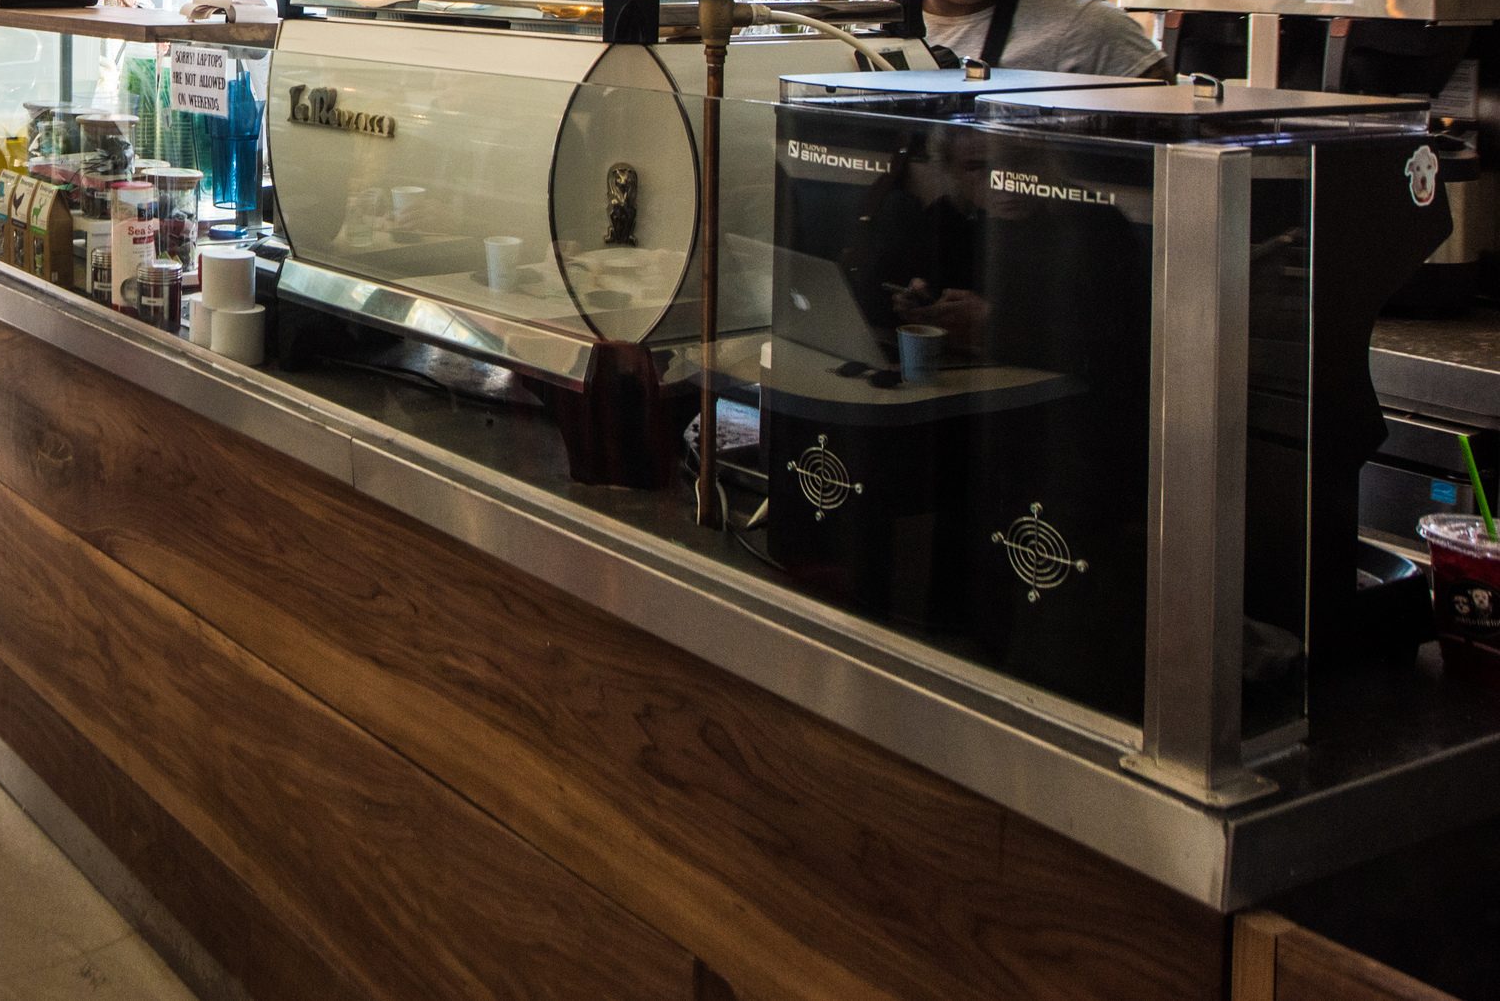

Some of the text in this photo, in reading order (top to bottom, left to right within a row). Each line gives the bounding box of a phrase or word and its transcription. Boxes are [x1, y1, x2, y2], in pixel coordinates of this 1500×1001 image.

[175, 50, 223, 69] SORRY! LAPTOPS
[172, 71, 226, 91] ARE NOT ALLOWED
[178, 92, 187, 106] ON
[801, 142, 828, 154] nuova
[801, 149, 891, 174] SIMONELLI
[1006, 171, 1038, 183] nuova
[1004, 179, 1115, 206] SIMONELLI
[128, 225, 146, 236] Sea
